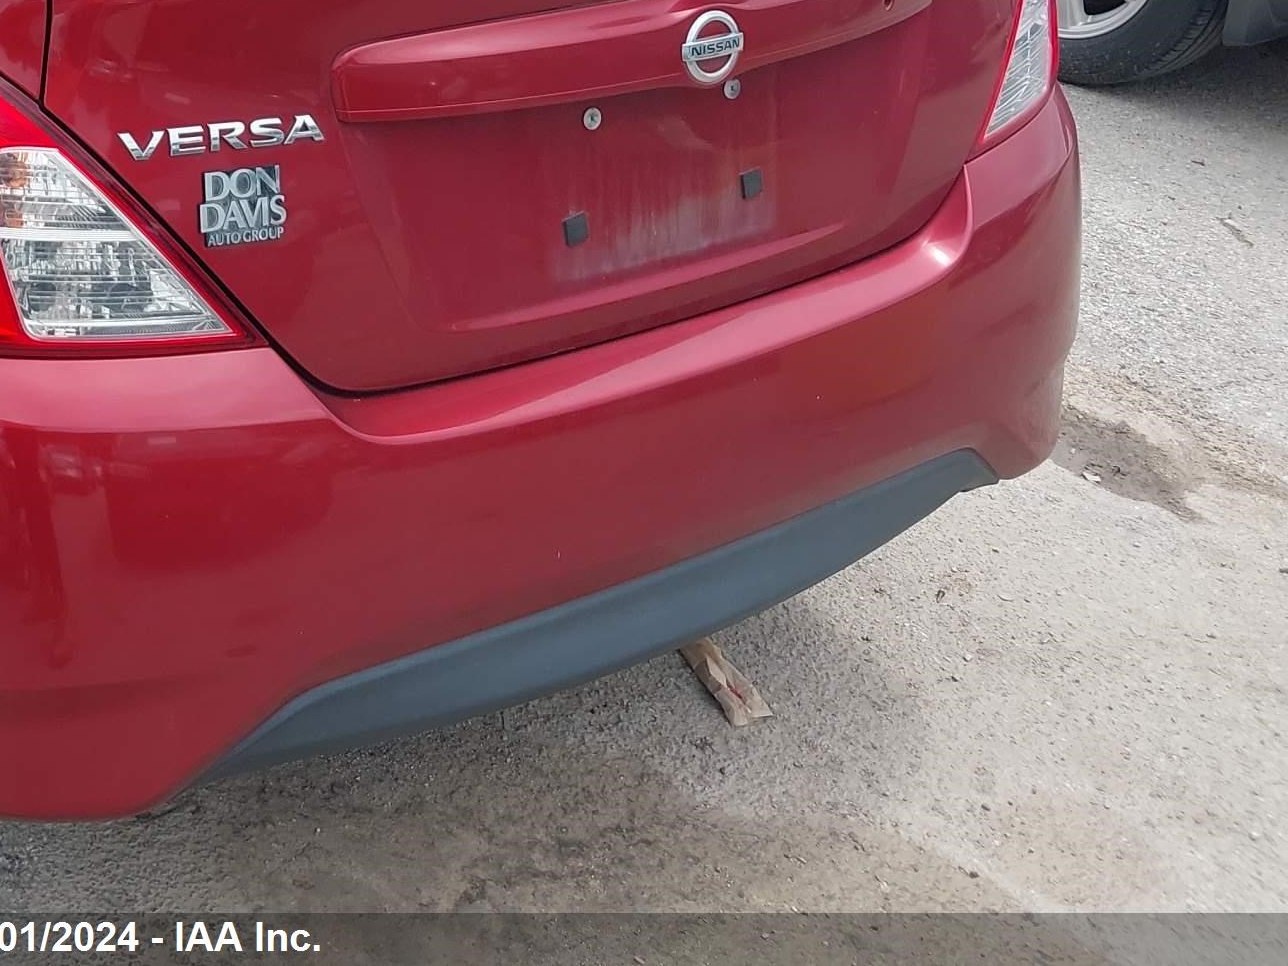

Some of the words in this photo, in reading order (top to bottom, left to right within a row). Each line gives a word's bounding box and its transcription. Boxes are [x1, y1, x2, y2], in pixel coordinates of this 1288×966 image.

[691, 38, 740, 57] NISSAN
[117, 114, 325, 161] VERSA
[204, 164, 281, 202] DON
[199, 194, 288, 234] DAVIS
[242, 226, 285, 243] GROUP
